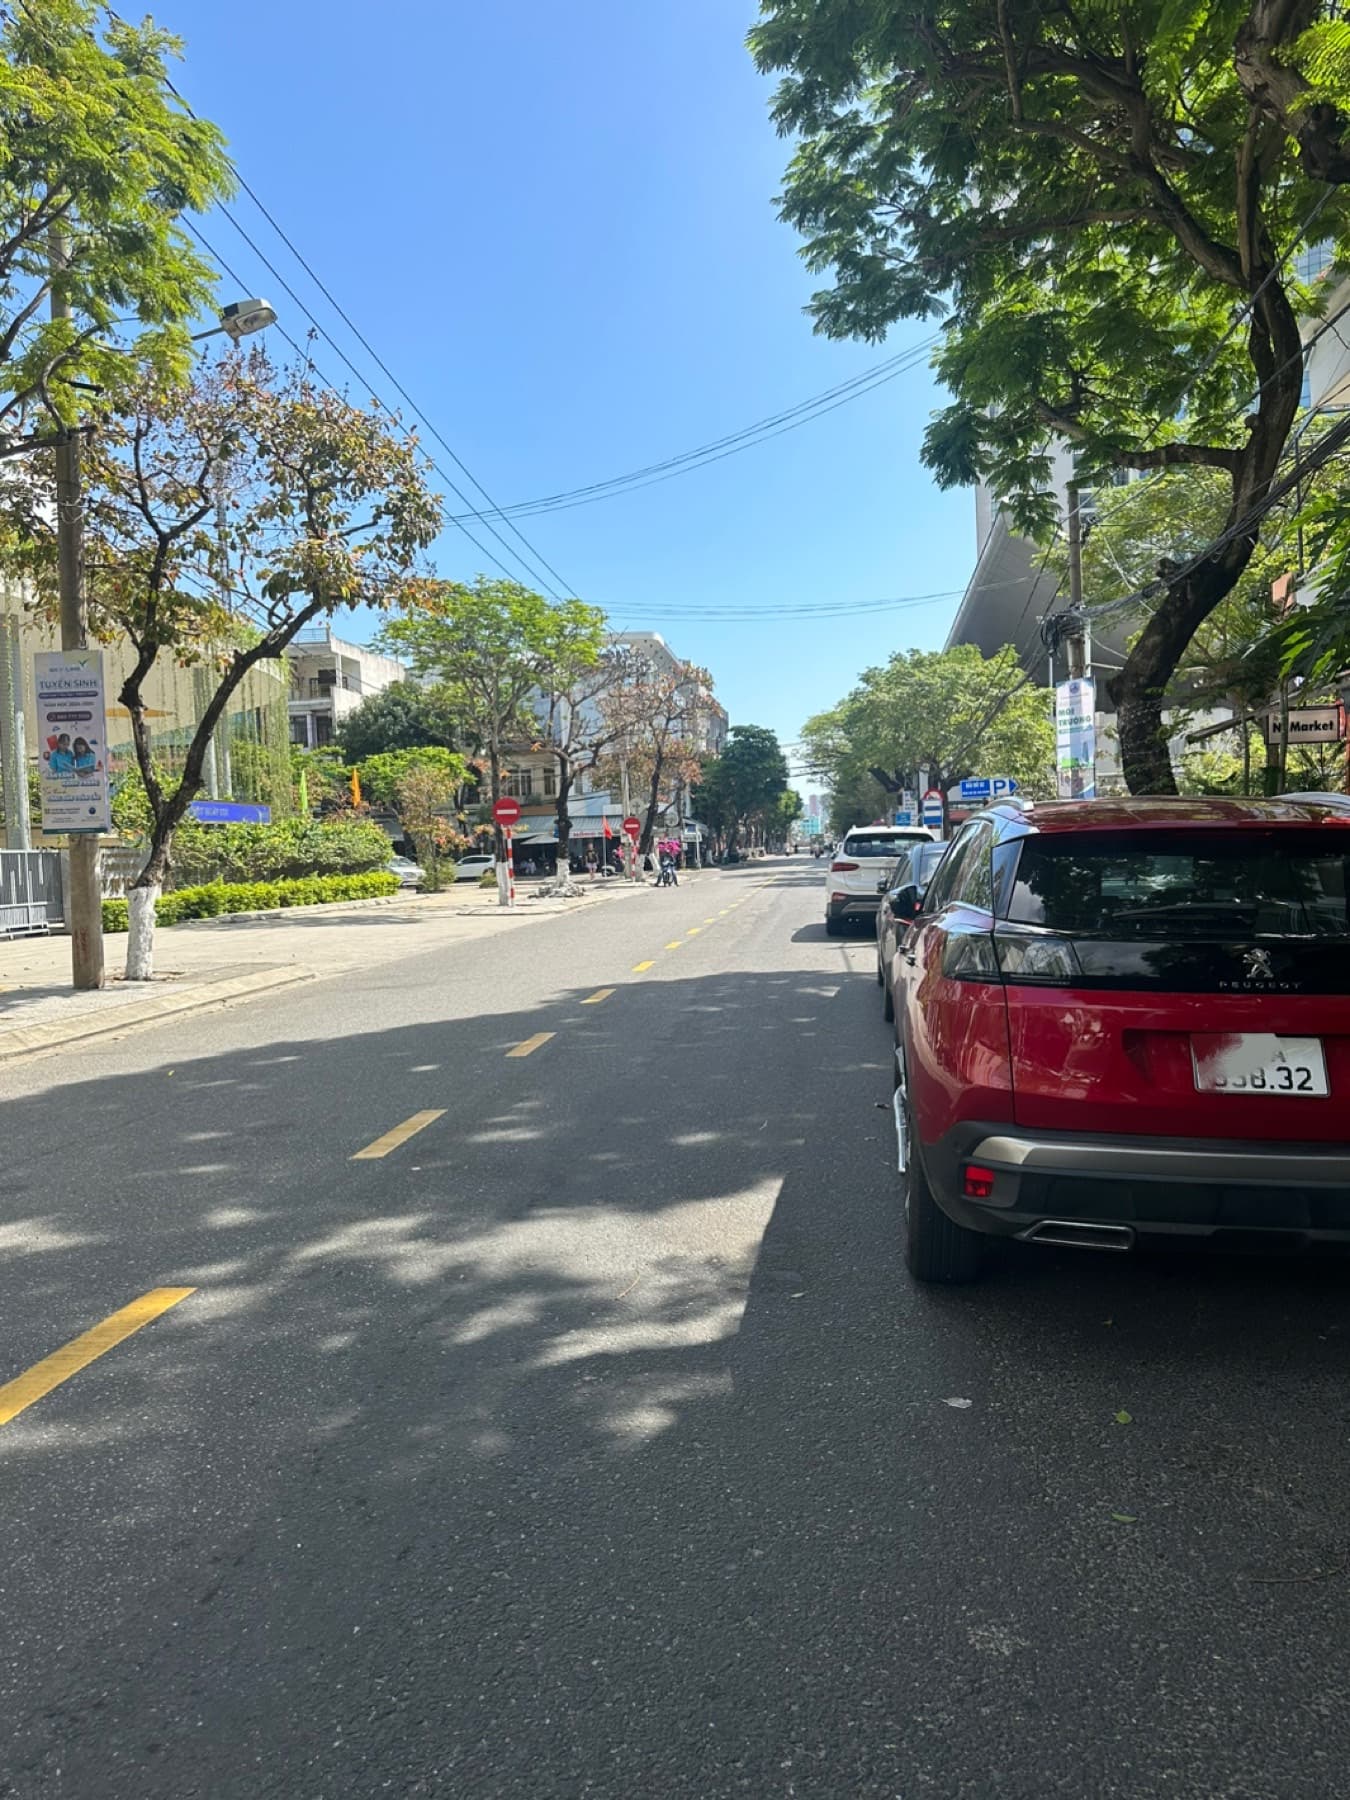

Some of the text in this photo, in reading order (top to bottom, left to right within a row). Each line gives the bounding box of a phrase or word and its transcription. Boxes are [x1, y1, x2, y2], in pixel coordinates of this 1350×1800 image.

[73, 679, 97, 687] SINH
[1290, 720, 1334, 732] Market
[993, 780, 1006, 794] P
[1219, 981, 1303, 989] PEUGEOT
